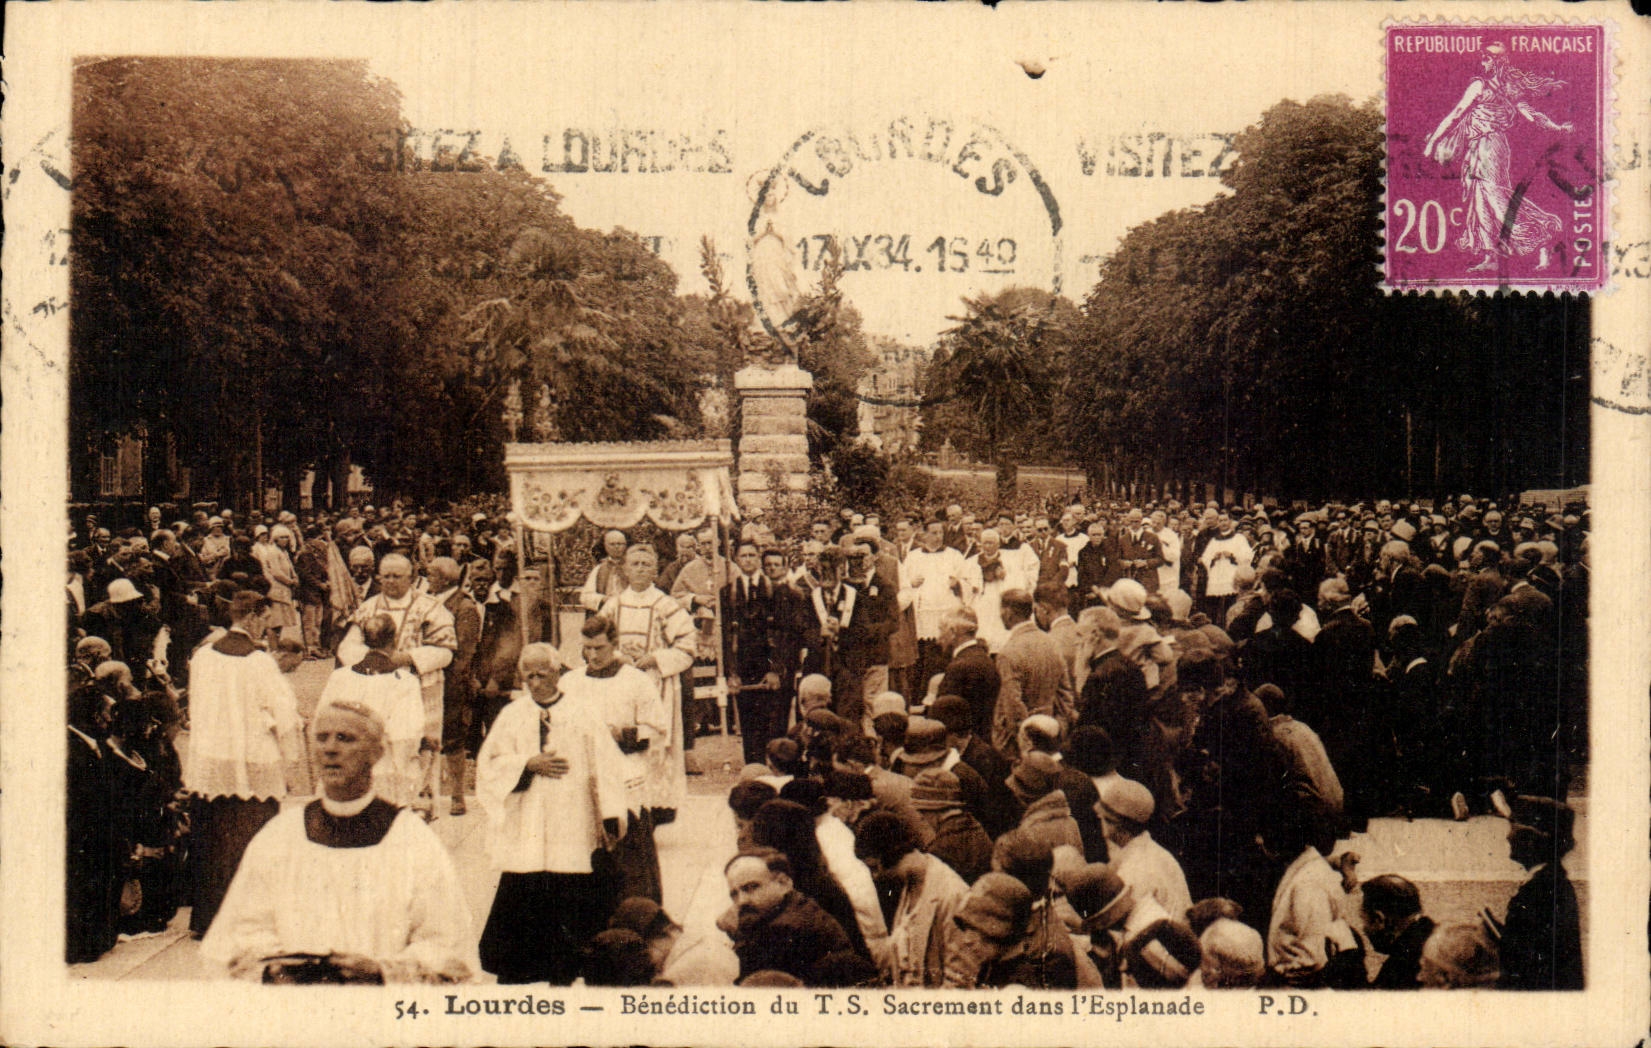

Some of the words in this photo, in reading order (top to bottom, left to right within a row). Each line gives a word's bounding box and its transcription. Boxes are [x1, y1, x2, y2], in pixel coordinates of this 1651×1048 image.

[1511, 35, 1593, 55] FRANÇAISE
[788, 116, 1017, 196] LOURDES
[1076, 131, 1237, 177] VISITEZ
